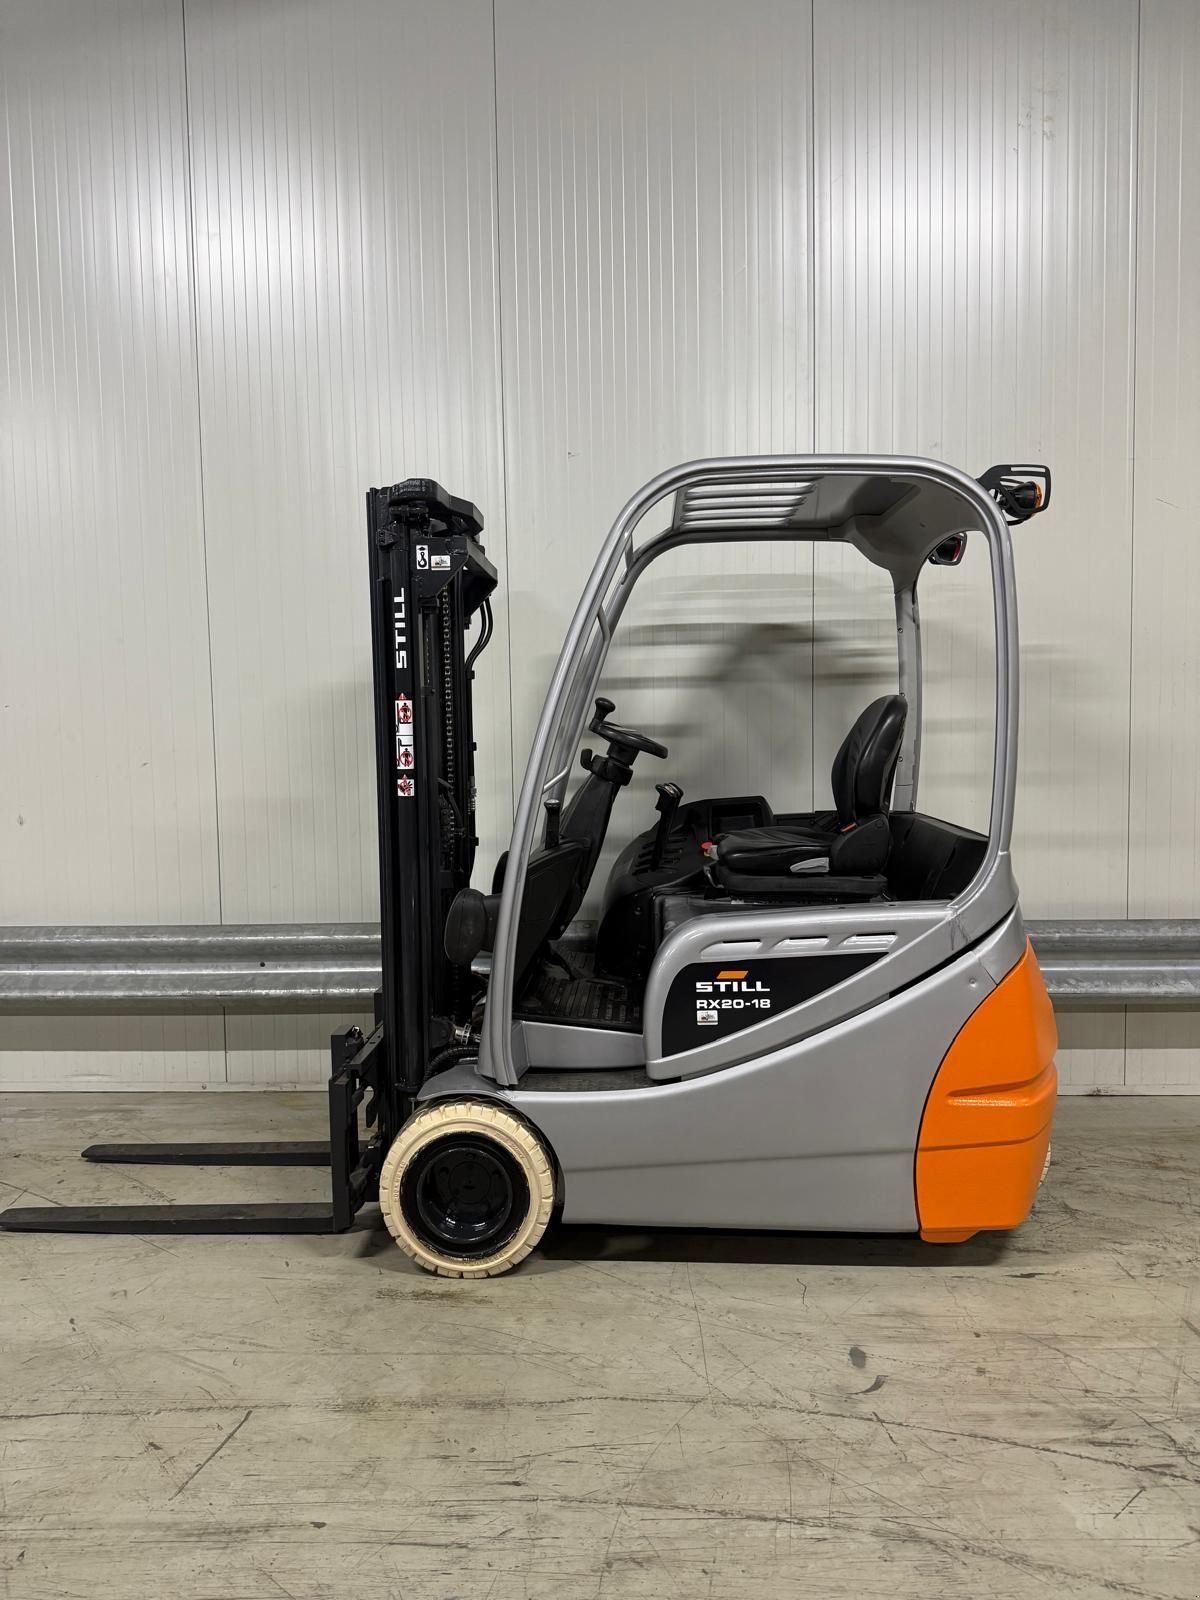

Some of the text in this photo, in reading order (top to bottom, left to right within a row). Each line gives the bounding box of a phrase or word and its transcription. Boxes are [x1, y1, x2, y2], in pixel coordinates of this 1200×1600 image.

[394, 587, 407, 669] STILL
[696, 981, 770, 992] STILL
[696, 999, 771, 1009] RX20-18
